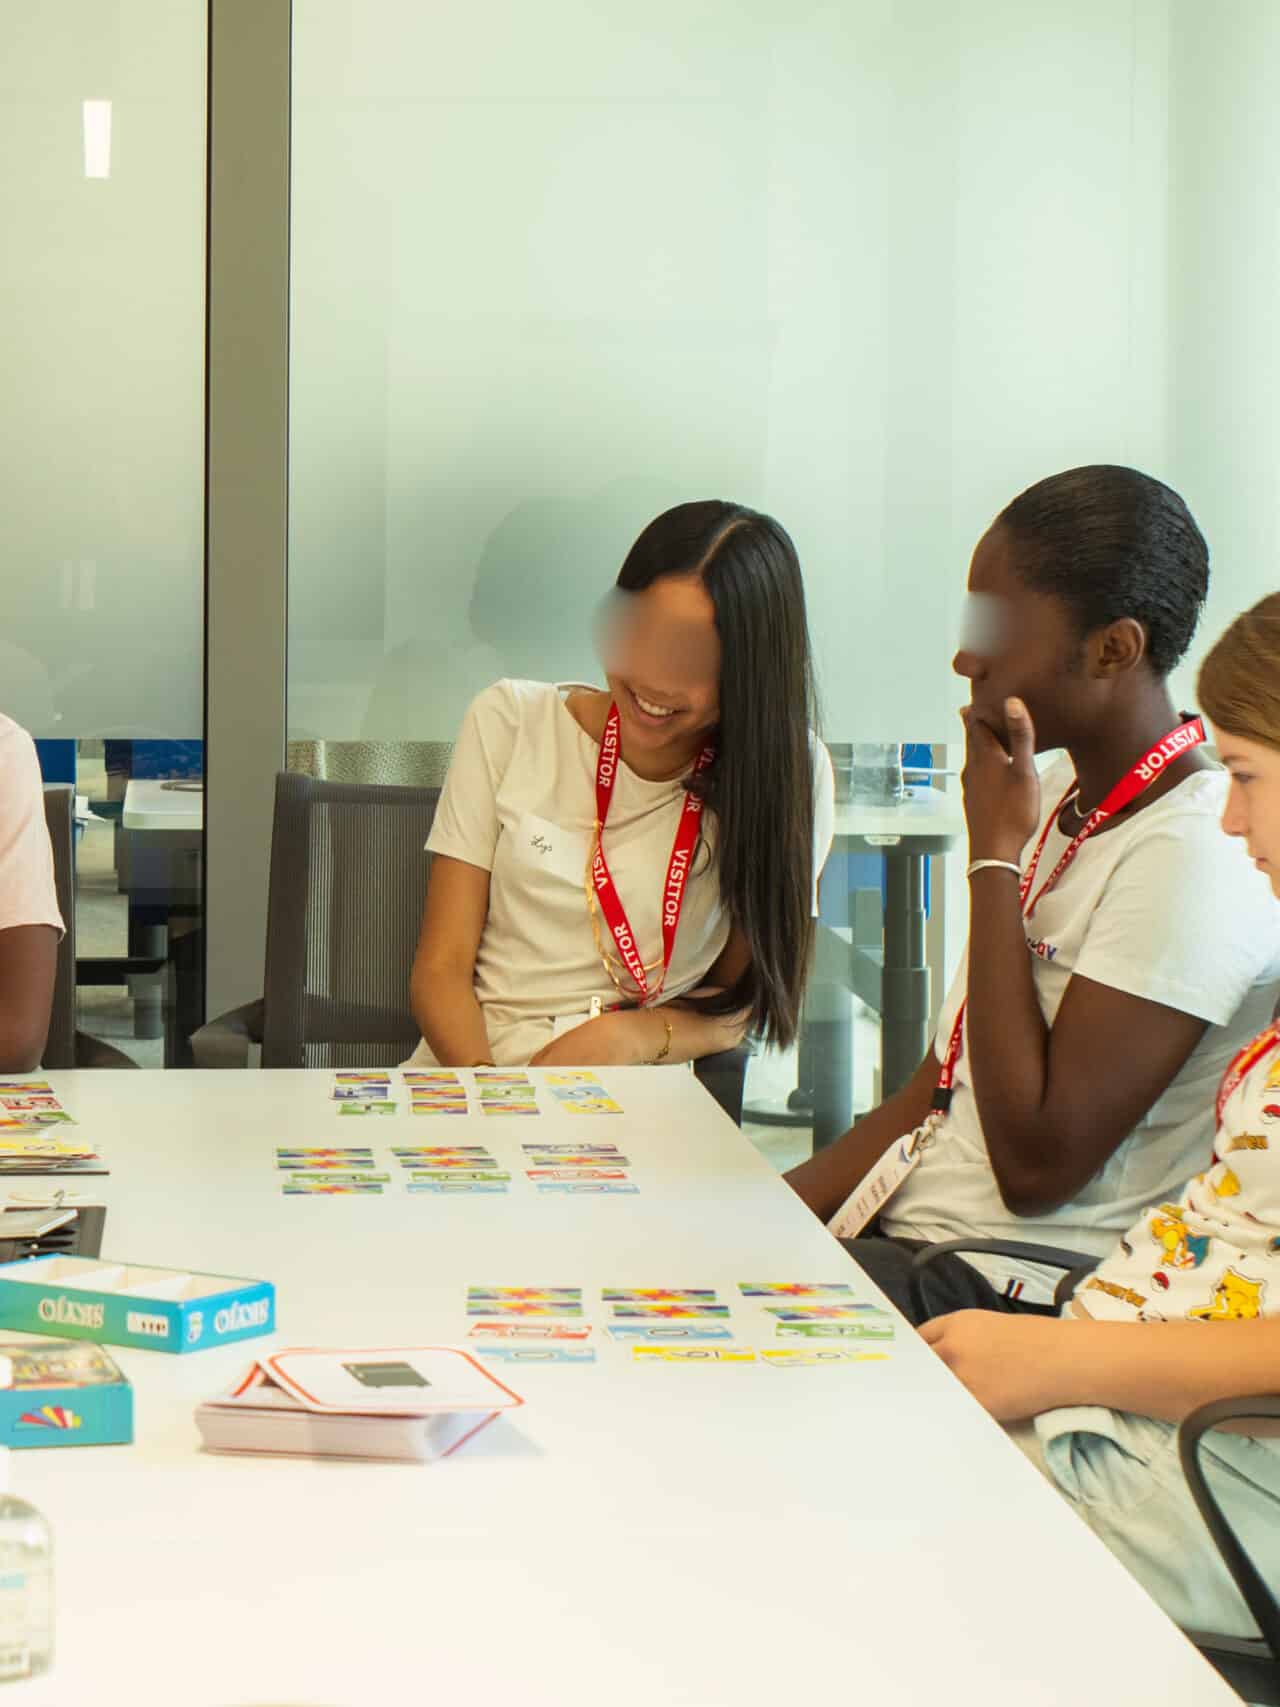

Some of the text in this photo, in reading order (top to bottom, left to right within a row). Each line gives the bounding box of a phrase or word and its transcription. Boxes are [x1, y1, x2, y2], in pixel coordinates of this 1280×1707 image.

[597, 714, 619, 788] VISITOR
[1134, 724, 1201, 781] VISITOR
[592, 848, 609, 890] VIS
[664, 849, 689, 927] VISITOR
[38, 1296, 105, 1329] SKYJO
[214, 1297, 270, 1334] SKYJO
